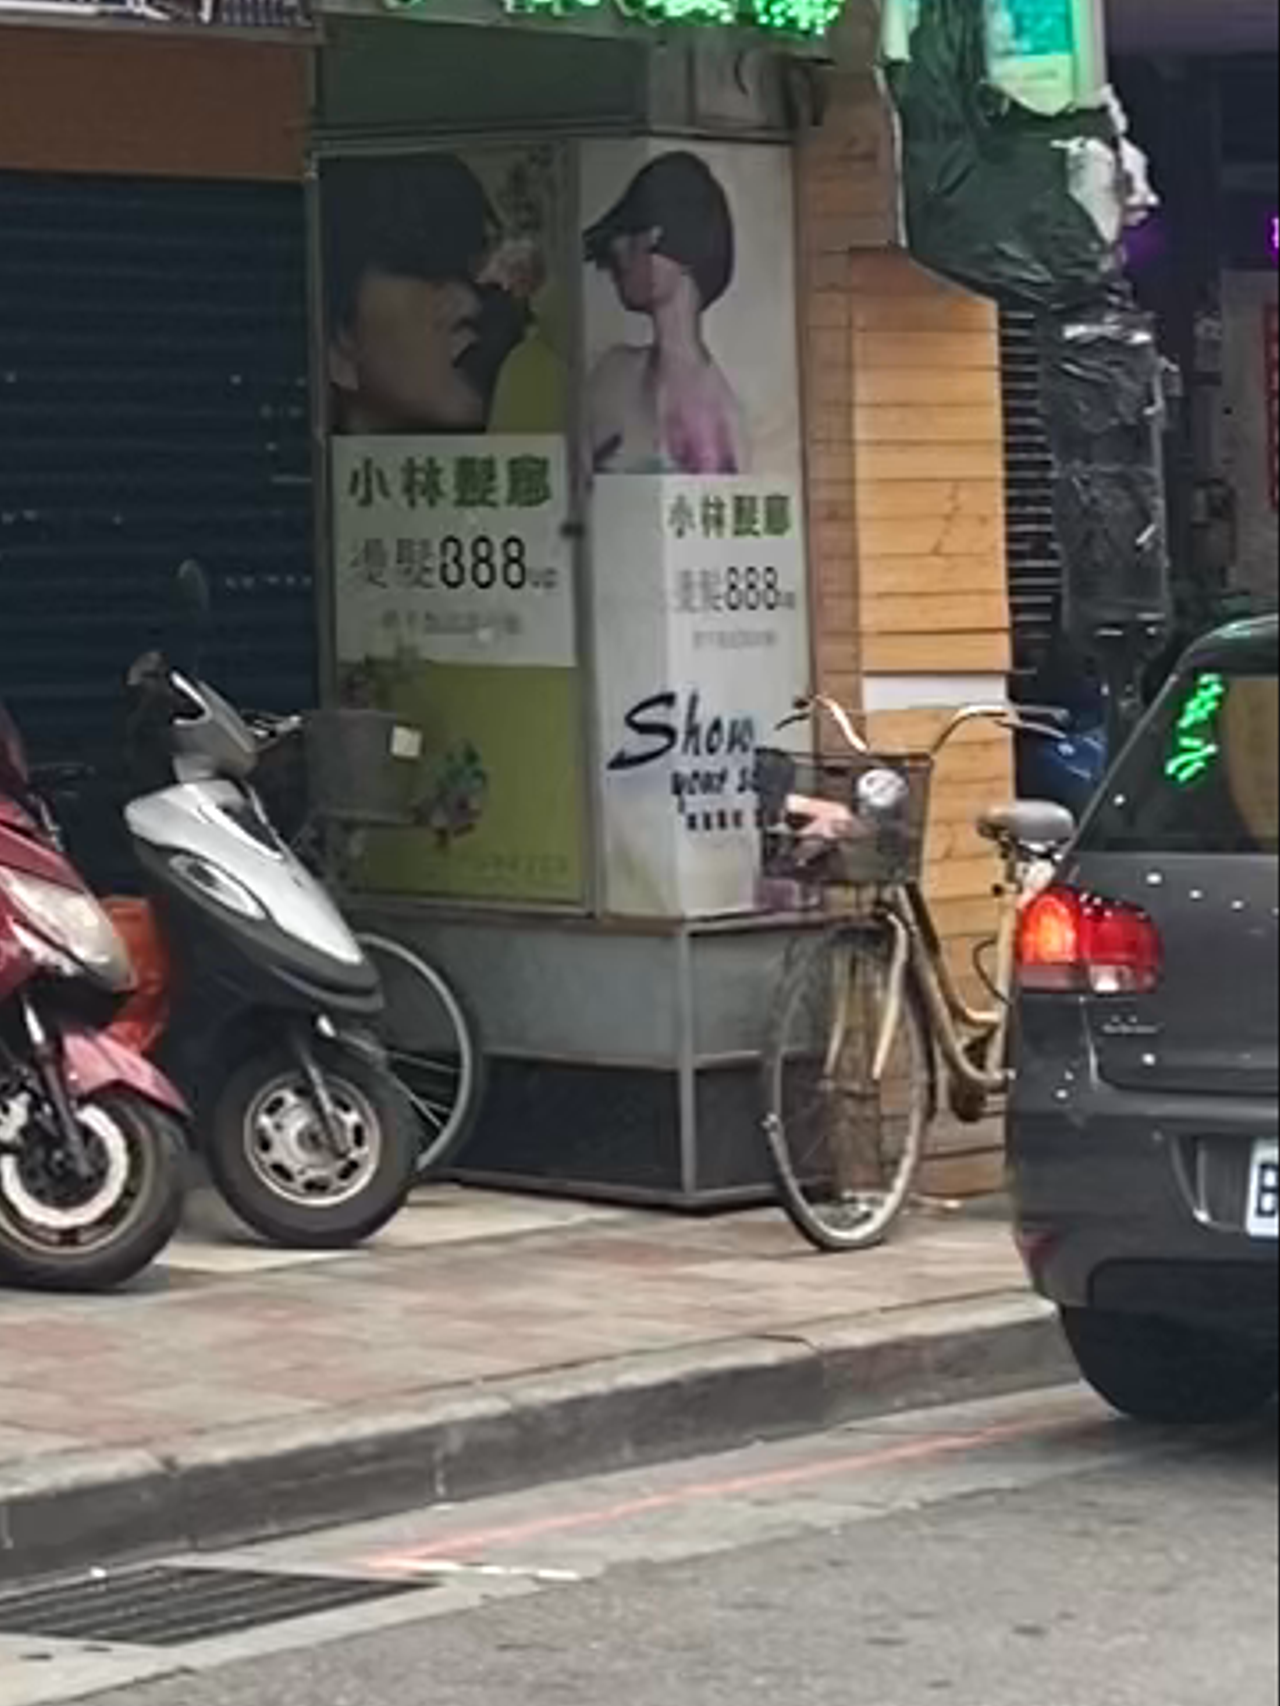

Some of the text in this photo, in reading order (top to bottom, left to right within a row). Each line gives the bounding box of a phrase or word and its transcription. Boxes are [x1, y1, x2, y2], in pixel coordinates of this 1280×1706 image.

[348, 456, 552, 508] 小林髮廊
[606, 689, 757, 771] Show
